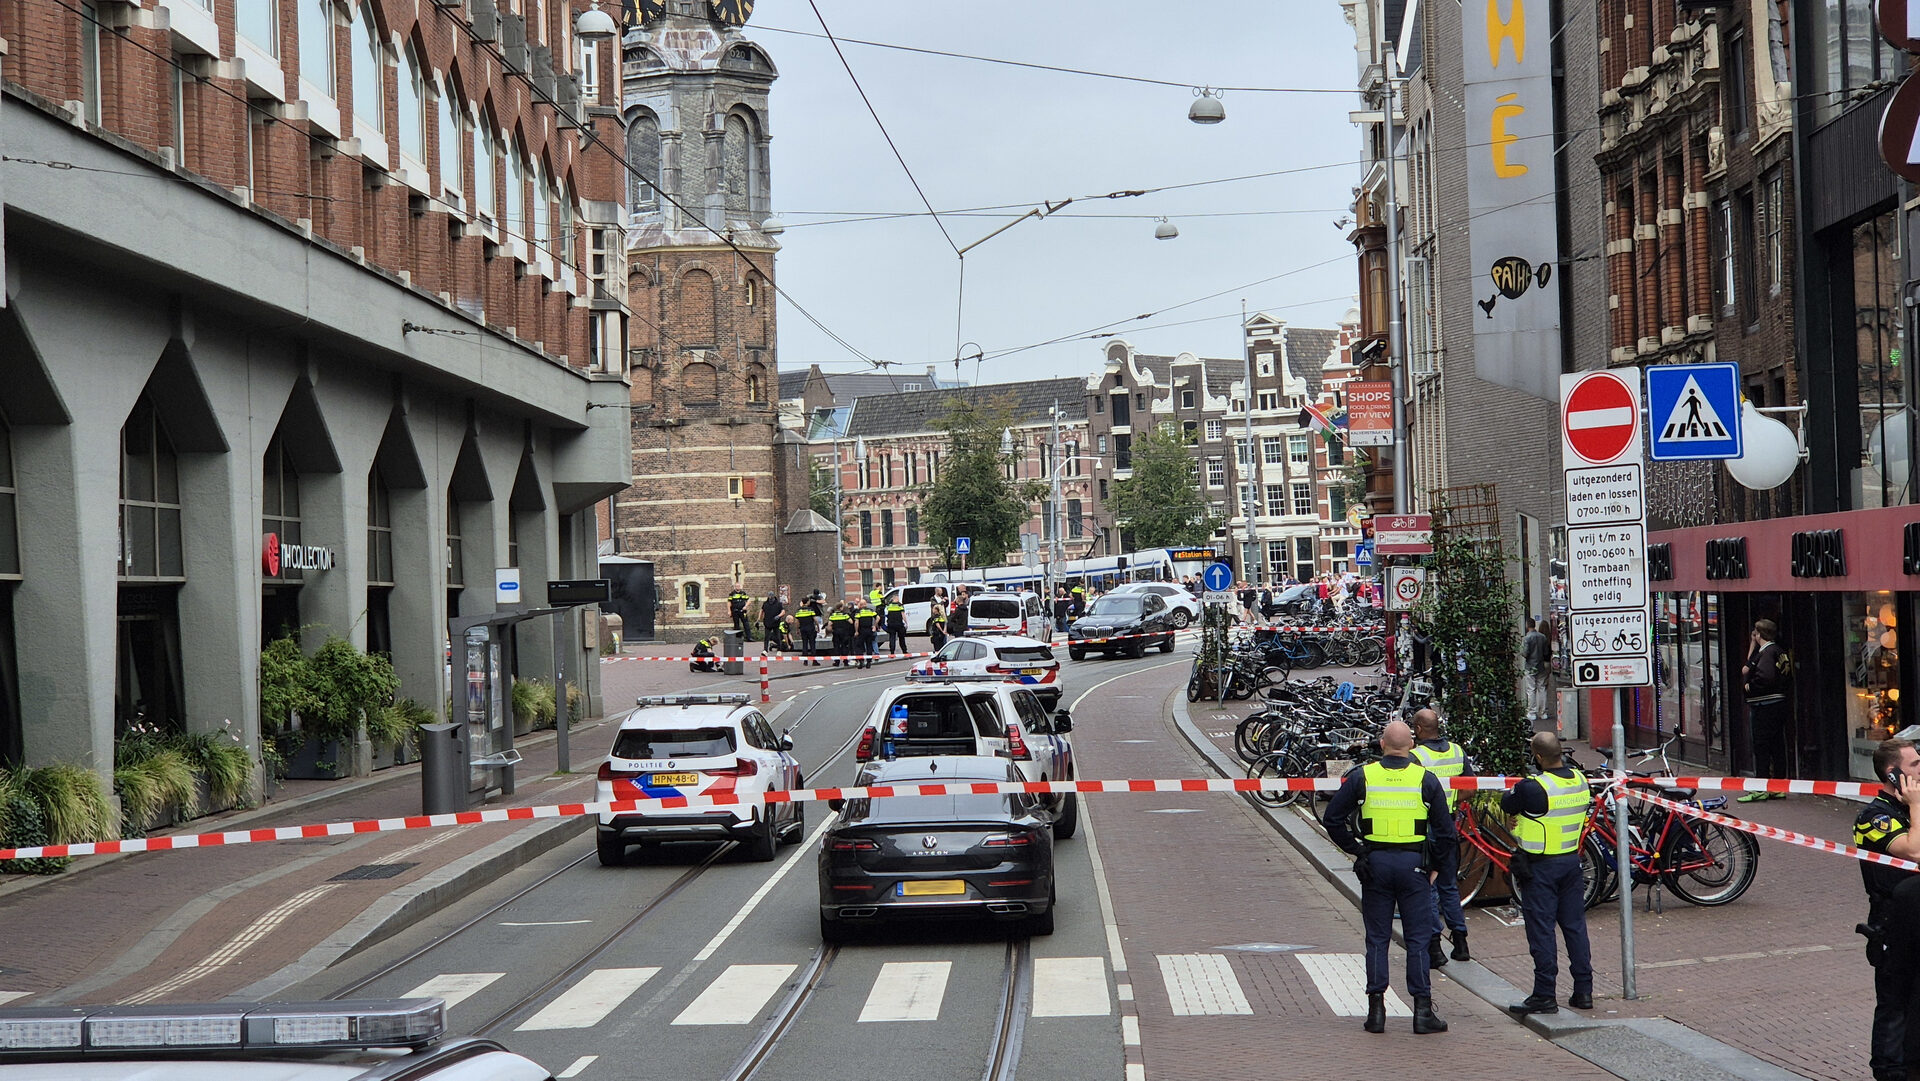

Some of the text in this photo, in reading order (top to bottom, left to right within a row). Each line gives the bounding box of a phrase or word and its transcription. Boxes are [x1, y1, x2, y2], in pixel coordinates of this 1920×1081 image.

[1349, 391, 1391, 402] SHOPS
[1350, 411, 1391, 419] CITY VIEW
[1573, 472, 1632, 487] uitgezonderd
[1569, 489, 1638, 502] laden en lossen
[1577, 504, 1631, 518] 0700-1100 h
[1579, 531, 1631, 546] vrij t/m zo
[291, 545, 332, 570] COLLECTION
[1577, 547, 1635, 560] 0100-0600 h
[1583, 563, 1630, 574] Trambaan
[1401, 583, 1416, 594] 30
[1582, 576, 1632, 588] ontheffing
[1593, 590, 1622, 604] geldig
[1575, 613, 1642, 627] uitgezonderd
[654, 774, 696, 784] HPN-48-G
